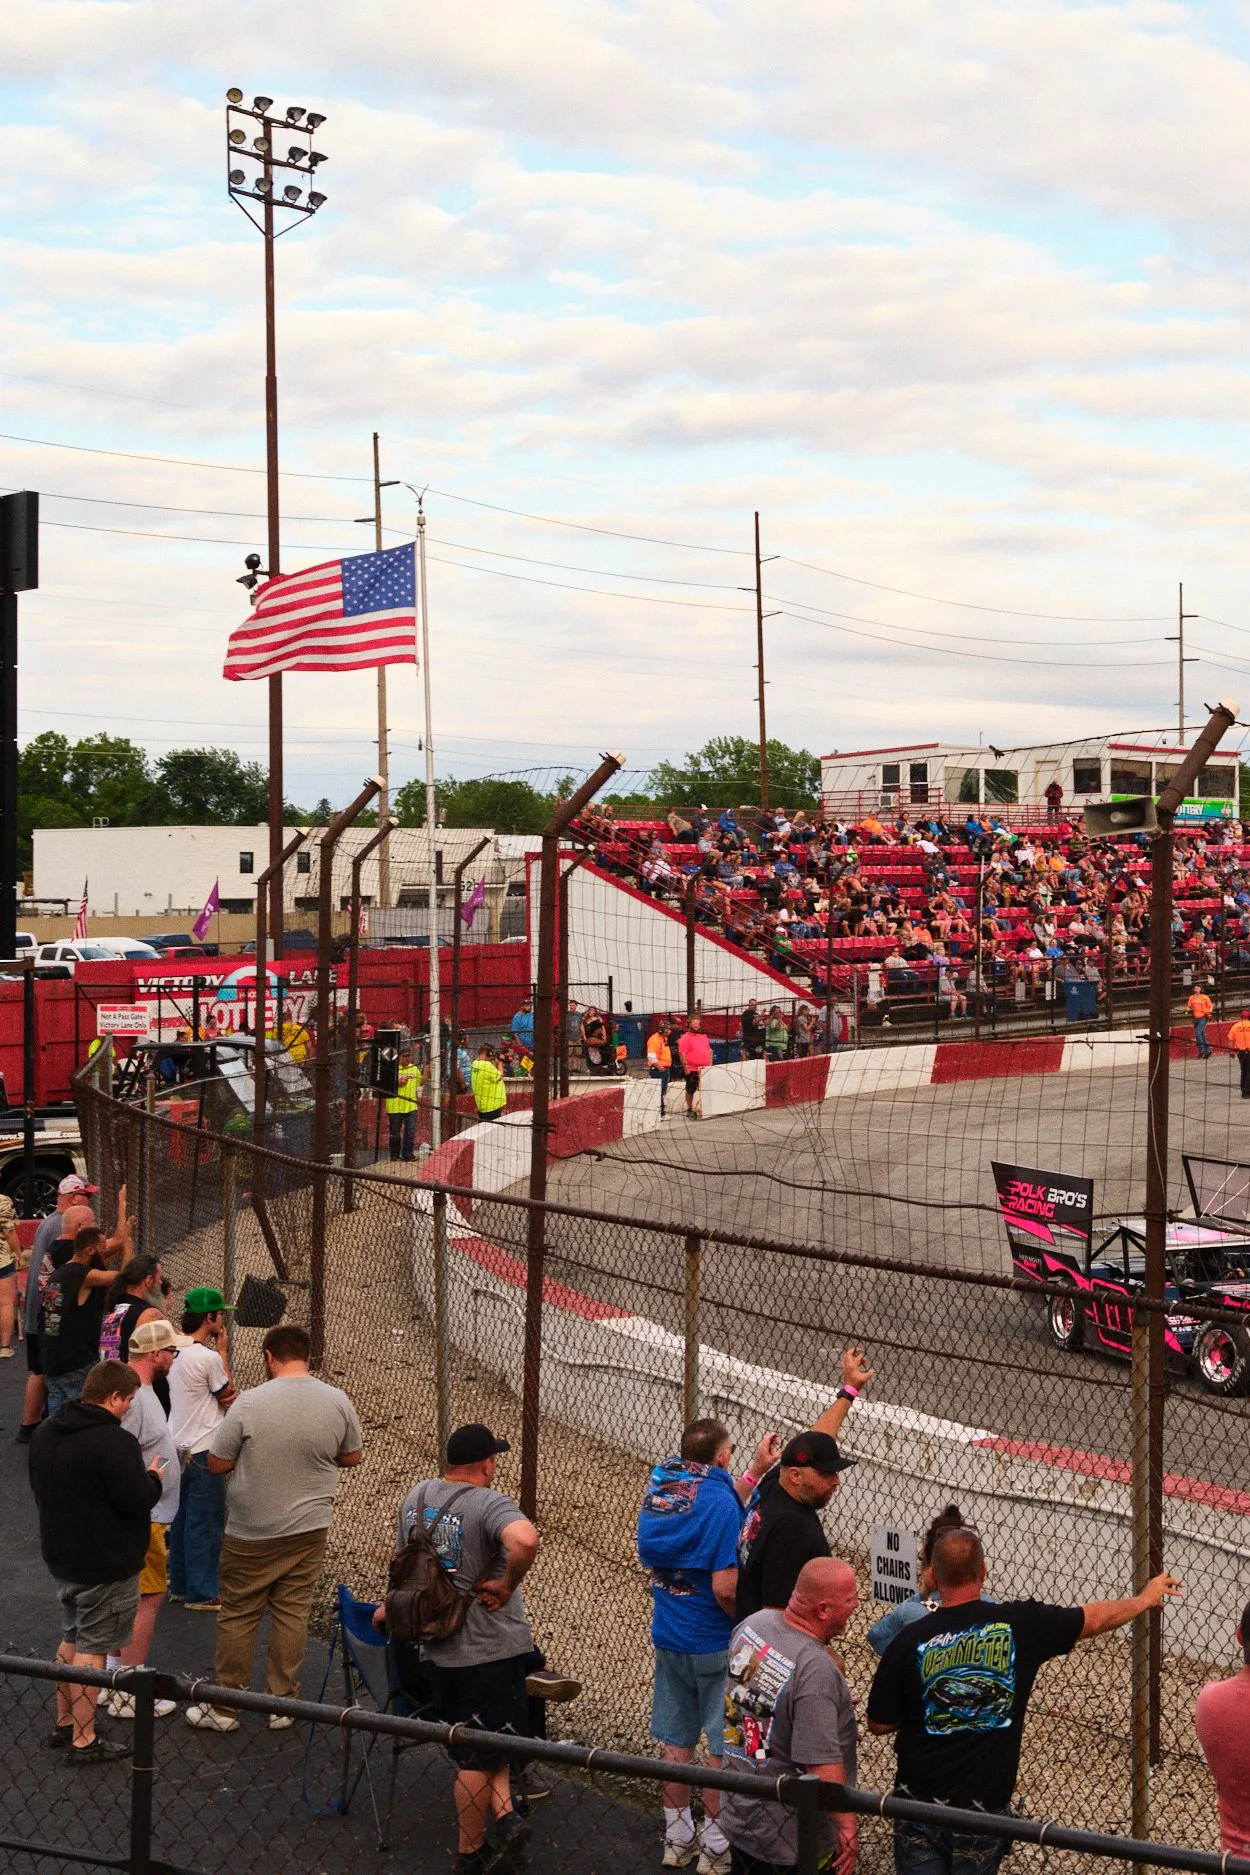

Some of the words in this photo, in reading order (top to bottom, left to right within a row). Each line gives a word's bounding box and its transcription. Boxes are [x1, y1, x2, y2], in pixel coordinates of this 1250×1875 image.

[1176, 803, 1204, 815] OTTERY
[289, 970, 338, 985] LAE
[1003, 1180, 1046, 1200] POLK
[1047, 1187, 1088, 1208] BRO'S
[1003, 1195, 1056, 1217] RACING
[887, 1531, 900, 1552] NO
[876, 1555, 911, 1581] CHAIRS
[874, 1581, 915, 1604] ALLOWED
[760, 1672, 781, 1689] good
